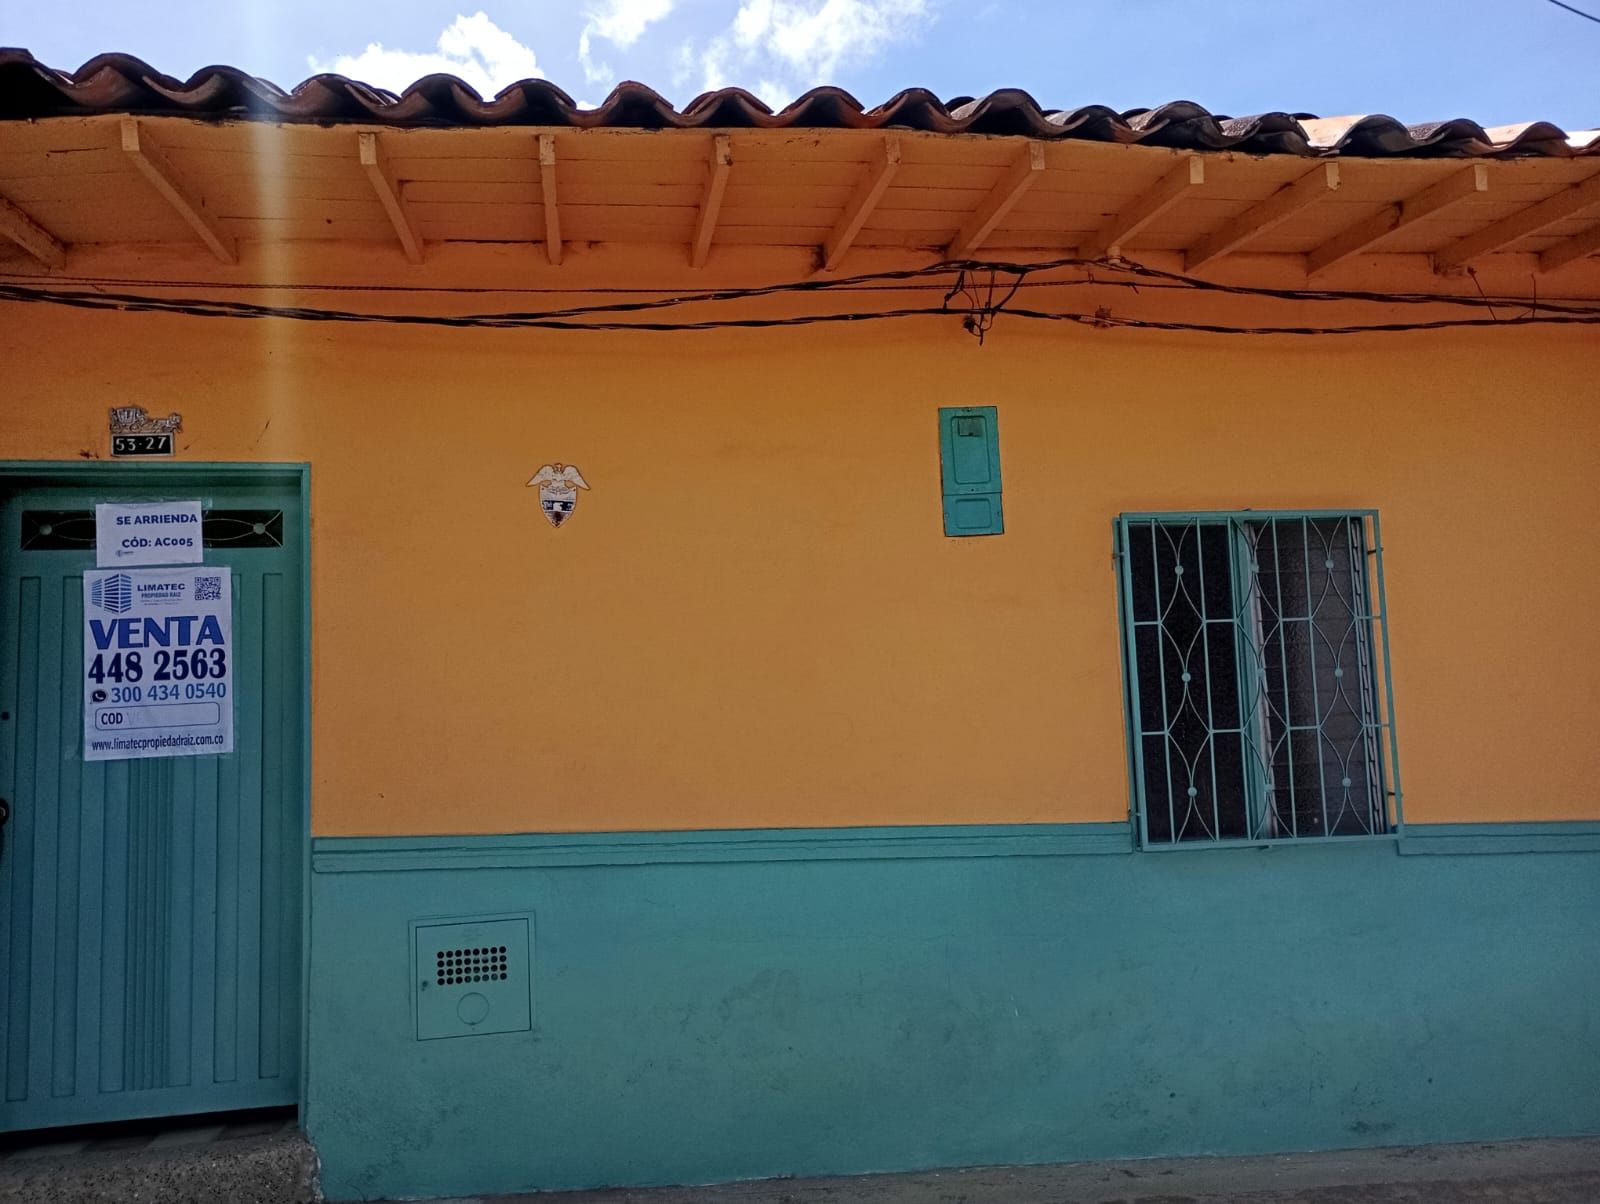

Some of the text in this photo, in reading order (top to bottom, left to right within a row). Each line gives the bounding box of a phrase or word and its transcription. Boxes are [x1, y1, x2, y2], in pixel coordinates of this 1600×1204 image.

[116, 513, 198, 525] SE ARRIENDA
[122, 536, 193, 548] CÓD: AC005
[137, 583, 186, 592] LIMATEC
[89, 615, 225, 650] VENTA
[88, 648, 227, 684] 448 2563
[111, 682, 227, 703] 300 434 0540
[101, 712, 123, 725] COD
[92, 734, 224, 751] www.limatecpropiedadraiz.com.co
